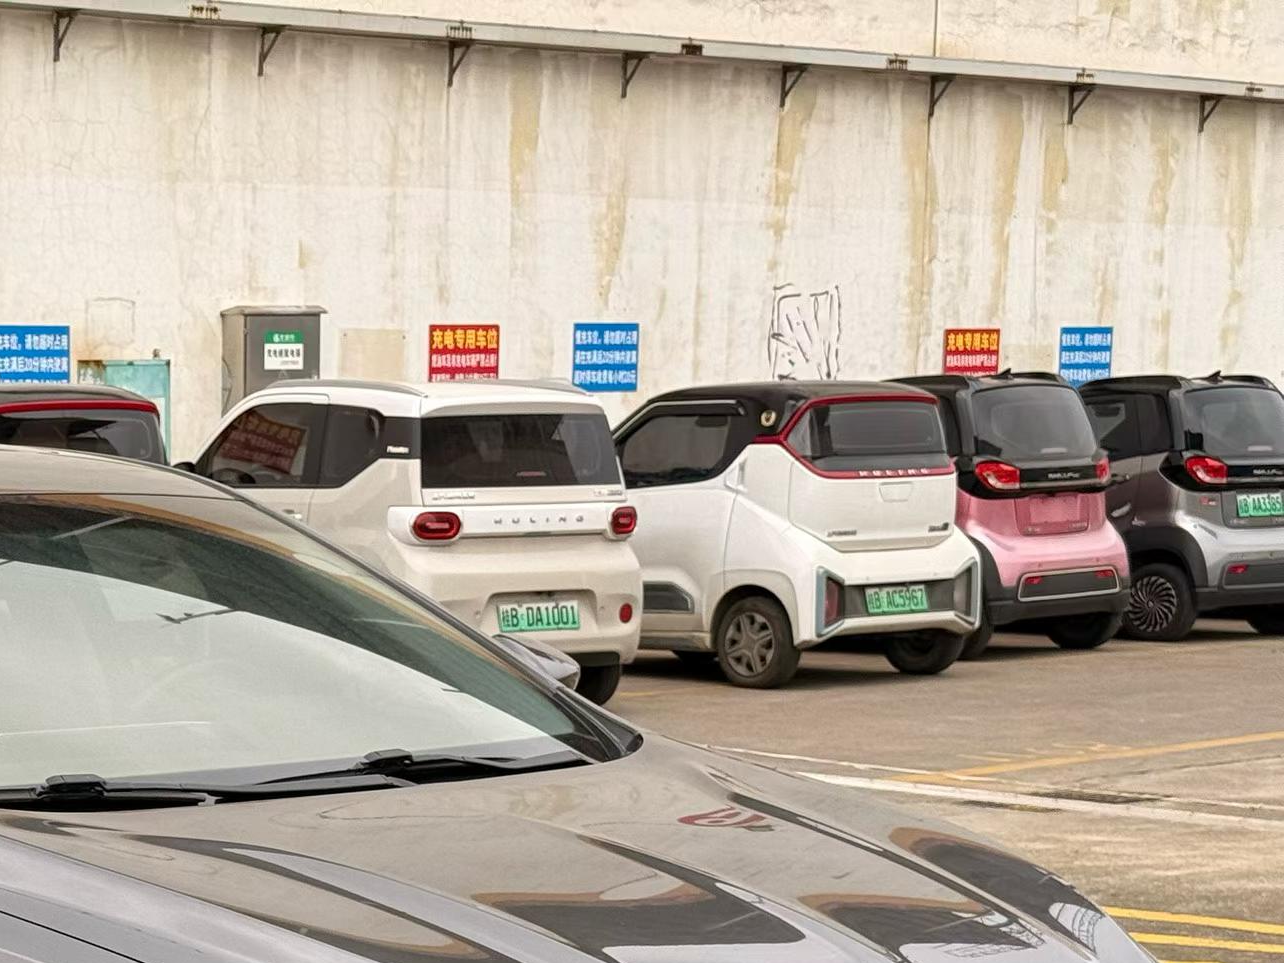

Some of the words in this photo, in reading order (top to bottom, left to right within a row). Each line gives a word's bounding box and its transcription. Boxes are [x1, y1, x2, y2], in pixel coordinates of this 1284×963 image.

[432, 328, 497, 349] 充电专用车位
[946, 331, 998, 351] 充电专用车位
